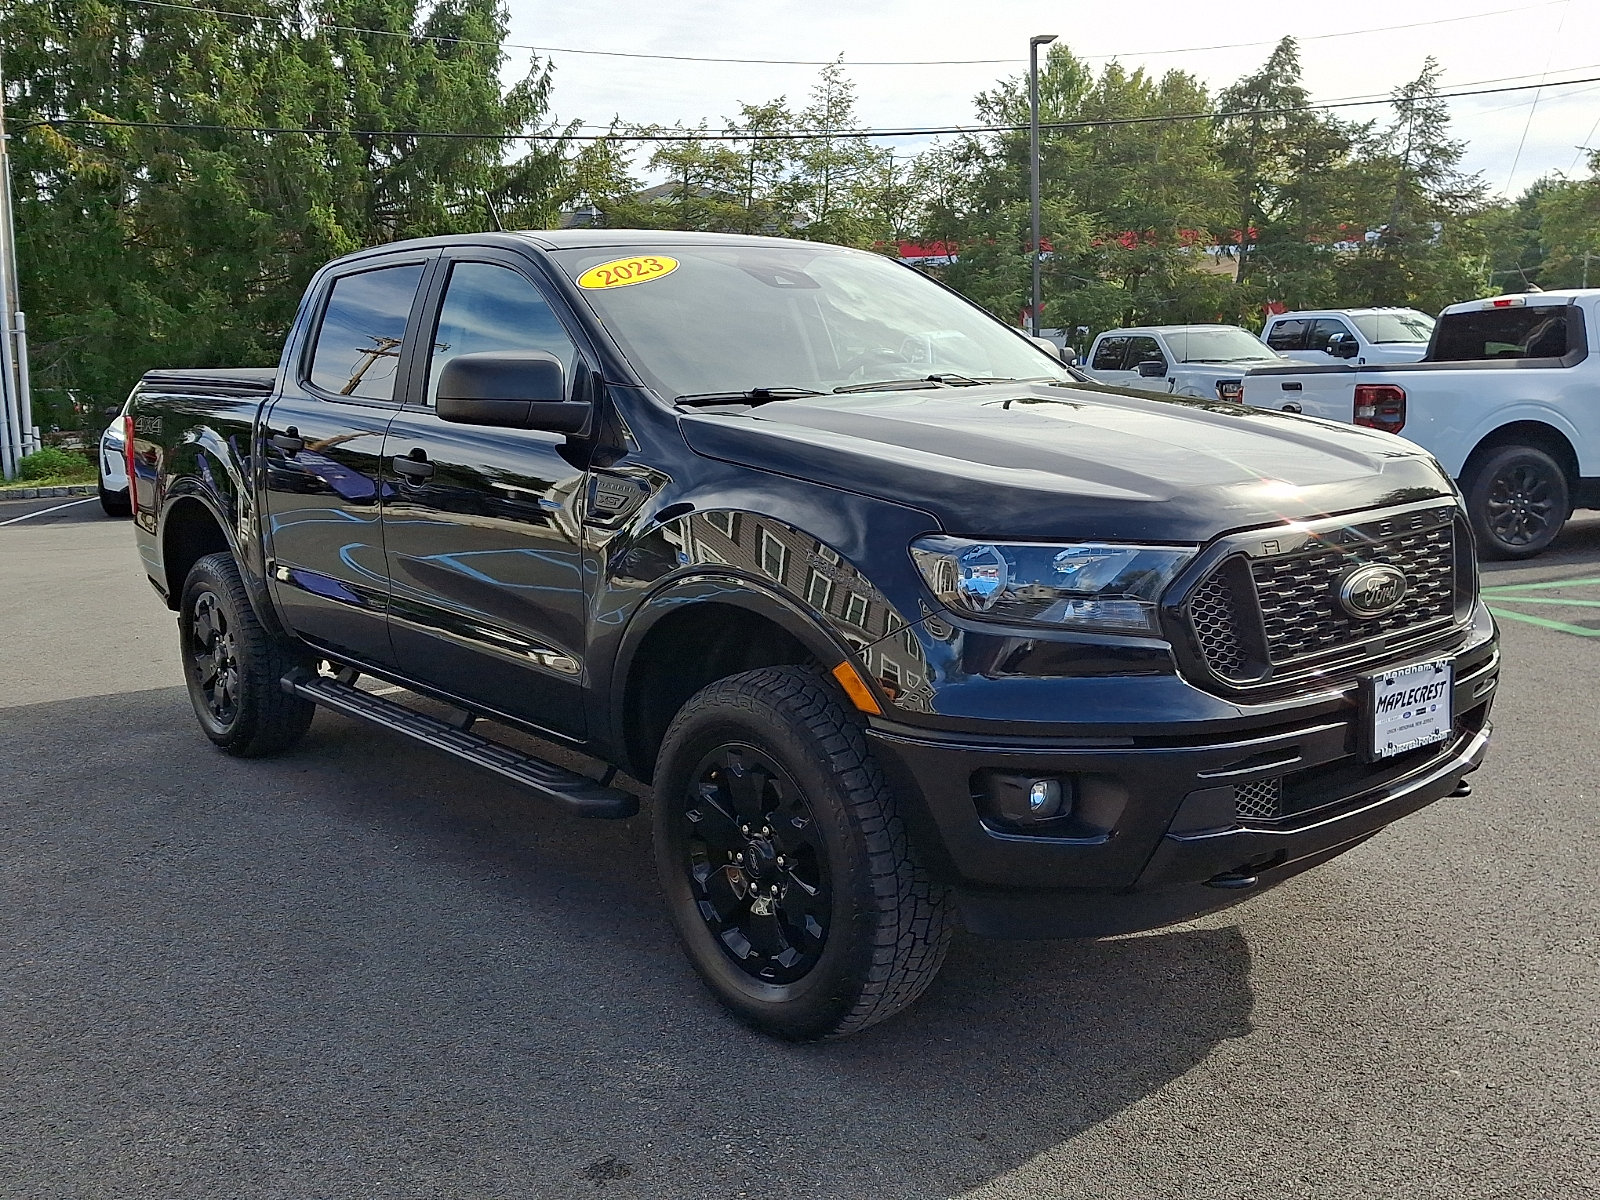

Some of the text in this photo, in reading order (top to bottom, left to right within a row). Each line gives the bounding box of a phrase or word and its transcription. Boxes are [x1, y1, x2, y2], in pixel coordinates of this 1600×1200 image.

[596, 258, 664, 285] 2023
[1364, 576, 1398, 606] Ford
[1375, 680, 1447, 714] MAPLECREST
